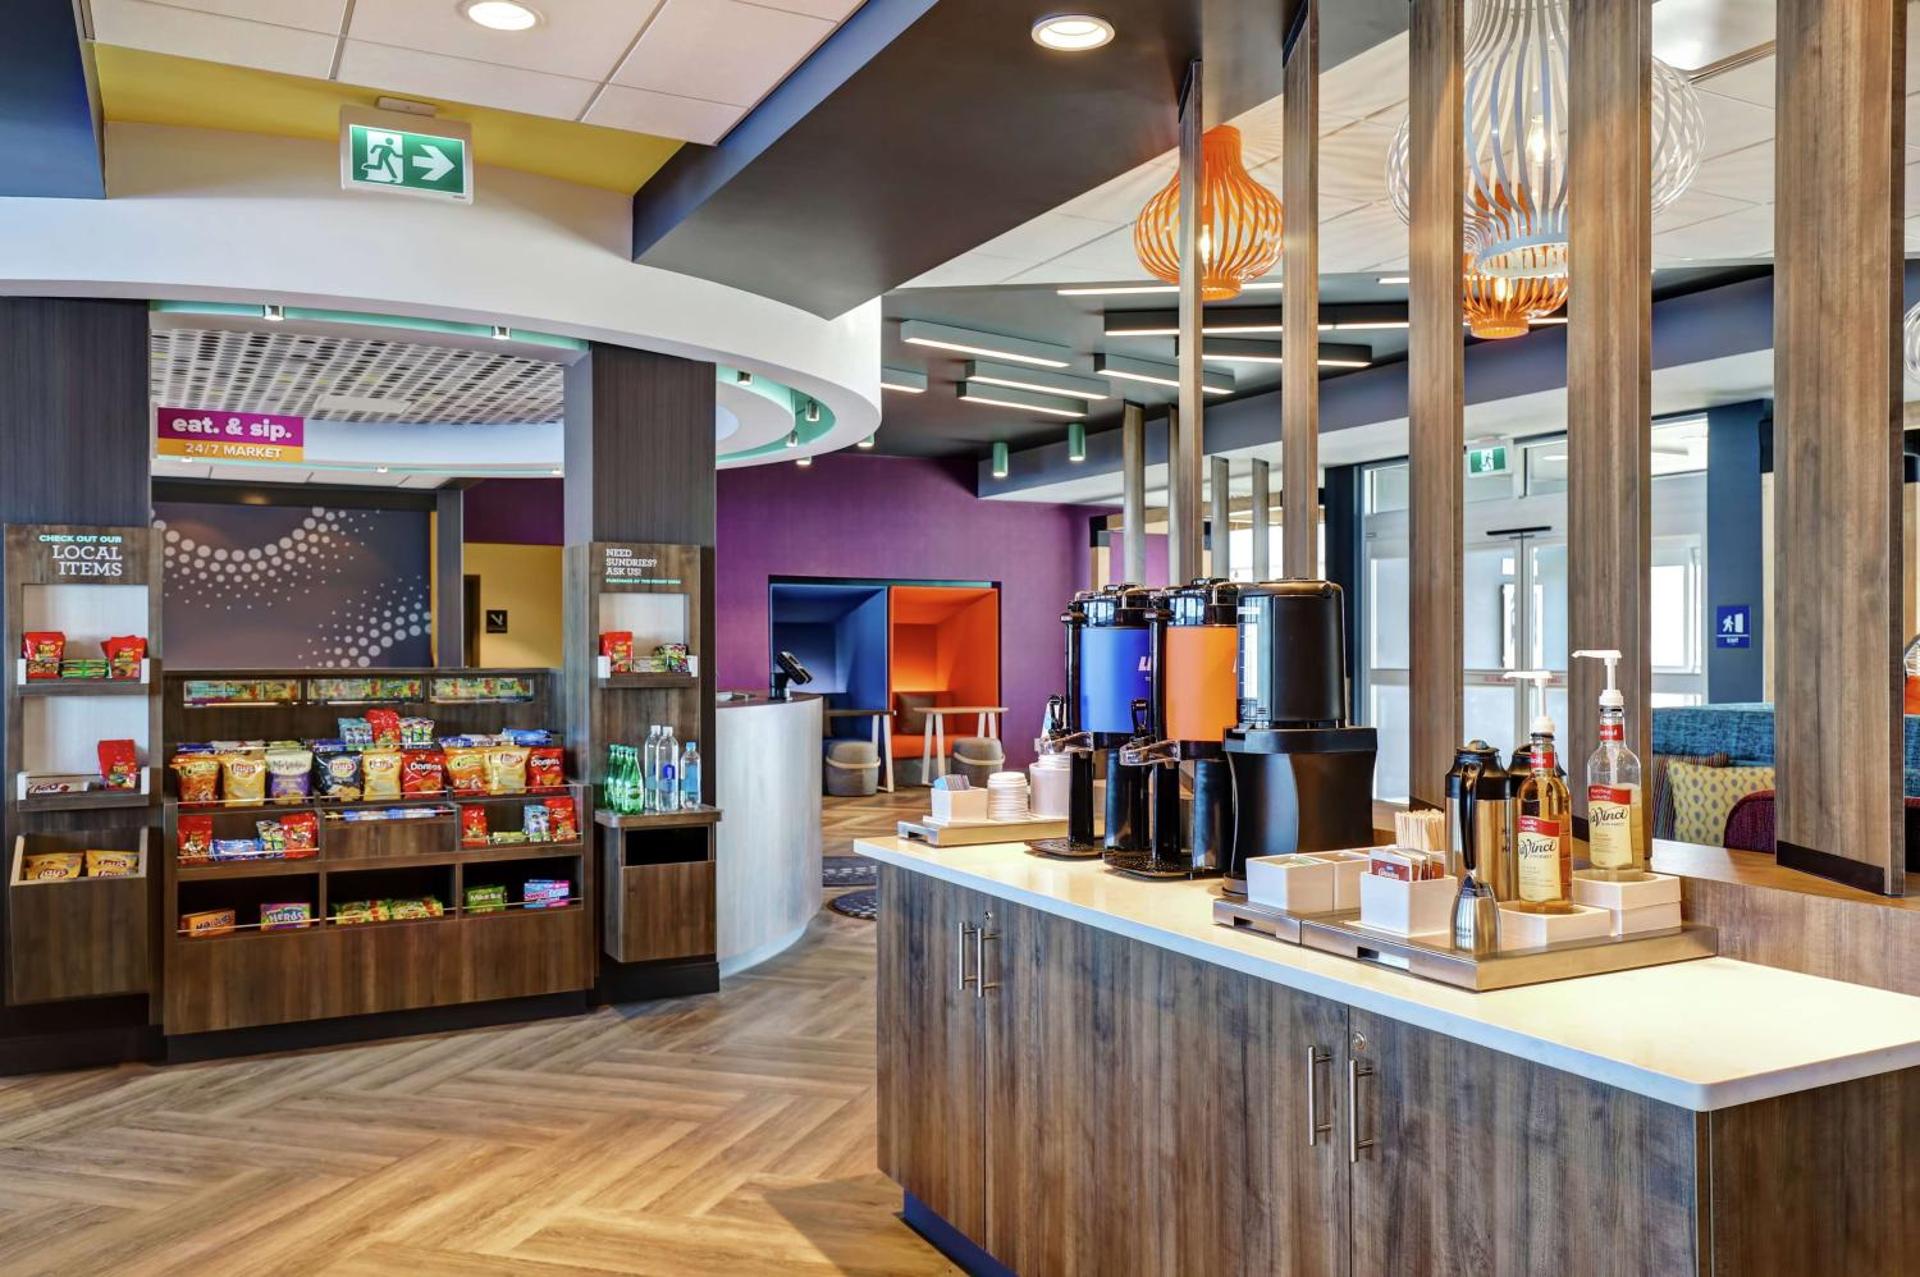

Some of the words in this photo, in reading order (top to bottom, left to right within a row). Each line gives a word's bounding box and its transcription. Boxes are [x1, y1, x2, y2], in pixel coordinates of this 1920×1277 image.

[172, 417, 220, 434] eat.
[225, 418, 243, 436] &
[250, 419, 292, 442] sip.
[185, 443, 219, 454] 24/7
[224, 445, 283, 459] MARKET
[39, 534, 75, 543] CHECK
[76, 535, 98, 544] OUT
[99, 535, 122, 544] OUR
[52, 545, 123, 561] LOCAL
[606, 548, 632, 557] NEED
[58, 561, 123, 577] ITEMS
[605, 567, 626, 576] ASK
